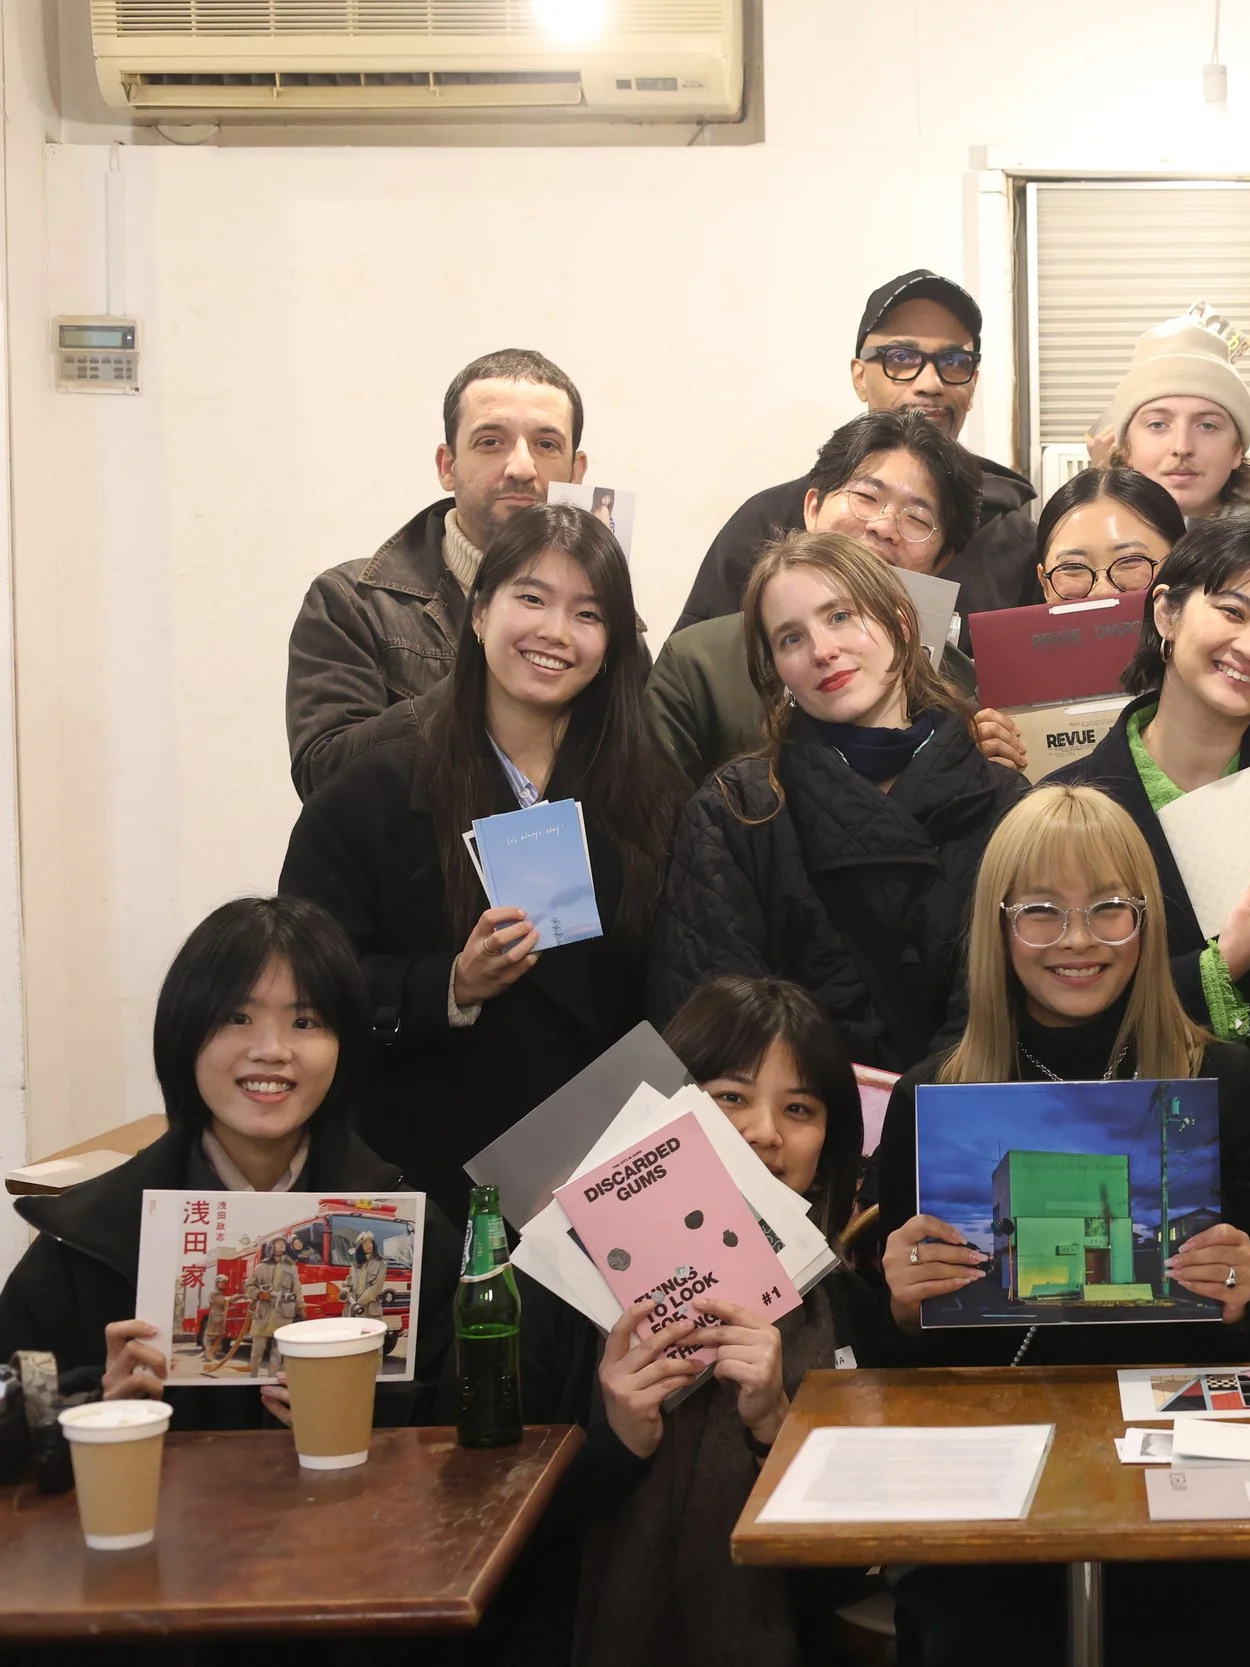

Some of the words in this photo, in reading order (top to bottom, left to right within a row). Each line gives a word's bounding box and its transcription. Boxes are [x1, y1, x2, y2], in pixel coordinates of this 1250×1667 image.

[1046, 729, 1096, 748] REVUE
[584, 1137, 681, 1203] DISCARDED
[617, 1165, 667, 1201] GUMS
[181, 1200, 210, 1288] 浅田家
[669, 1271, 719, 1308] LOOK
[762, 1286, 781, 1306] #1
